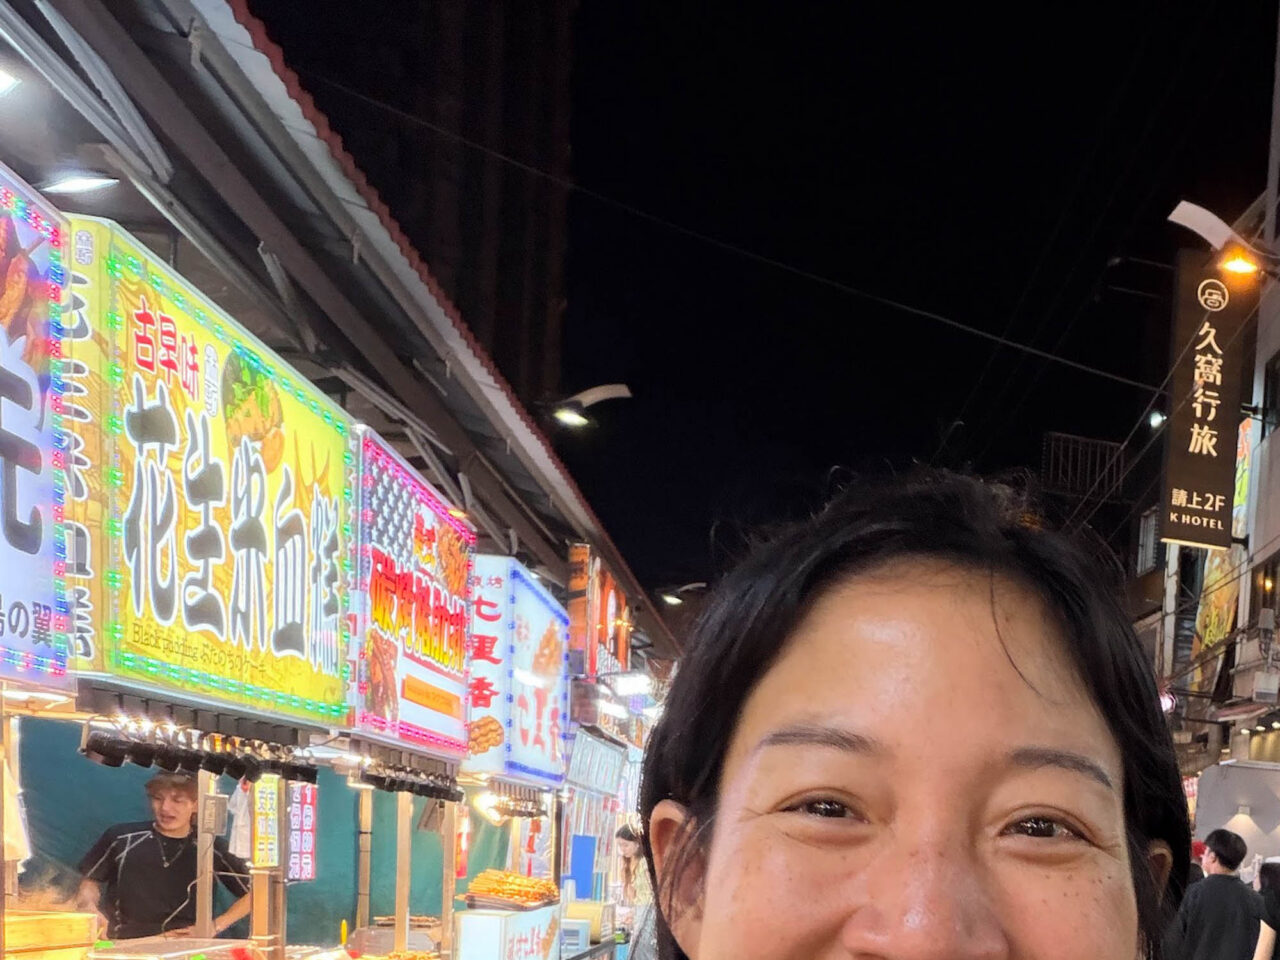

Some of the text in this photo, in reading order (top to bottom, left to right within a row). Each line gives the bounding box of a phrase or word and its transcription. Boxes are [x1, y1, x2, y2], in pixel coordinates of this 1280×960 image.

[134, 294, 200, 402] 古早味
[1188, 321, 1224, 457] 久窩行旅
[123, 372, 341, 678] 花生米血糕
[1170, 512, 1224, 530] K HOTEL
[1171, 488, 1226, 512] 請上2F
[470, 595, 503, 709] 七里香
